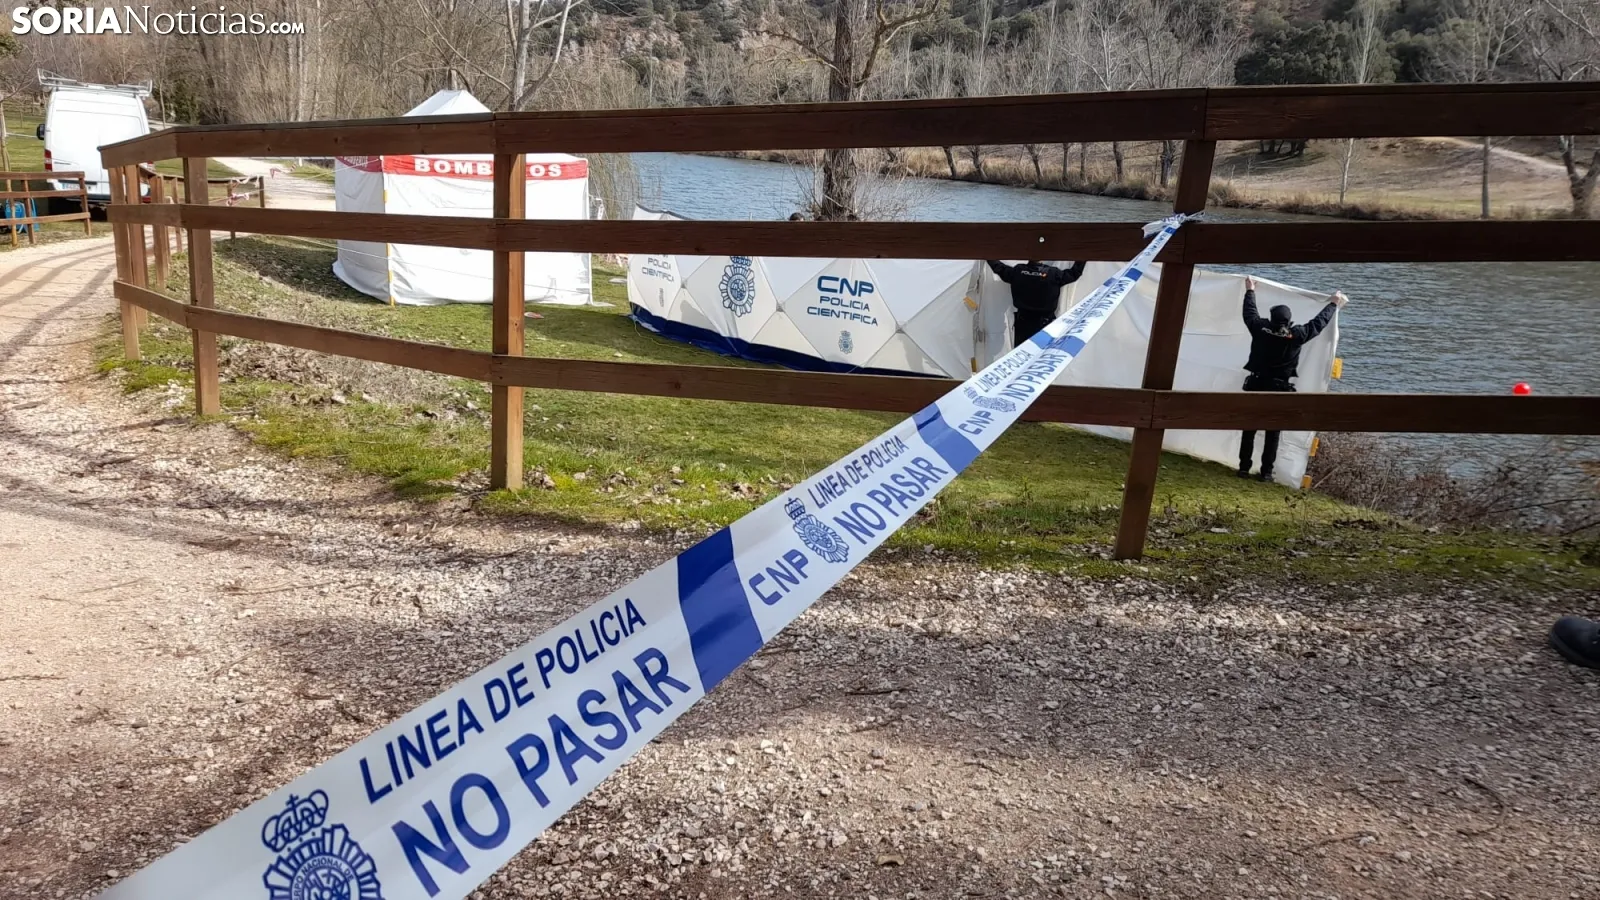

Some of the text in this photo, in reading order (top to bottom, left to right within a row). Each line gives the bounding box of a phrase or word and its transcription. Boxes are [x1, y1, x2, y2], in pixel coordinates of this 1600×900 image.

[414, 158, 562, 177] BOMBOS
[817, 275, 874, 297] CNP
[820, 296, 870, 312] POLICIA
[806, 306, 878, 326] CIENTIFICA
[974, 350, 1033, 393] LINEA DE POLICIA
[998, 353, 1067, 402] NO PASAR
[958, 410, 995, 436] CNP
[808, 435, 909, 509] LINEA DE POLICIA
[832, 456, 948, 545] NO PASAR
[749, 549, 809, 606] CNP
[359, 598, 647, 804] LINEA DE POLICIA
[391, 647, 692, 898] NO PASAR
[301, 857, 343, 876] NACIONAL
